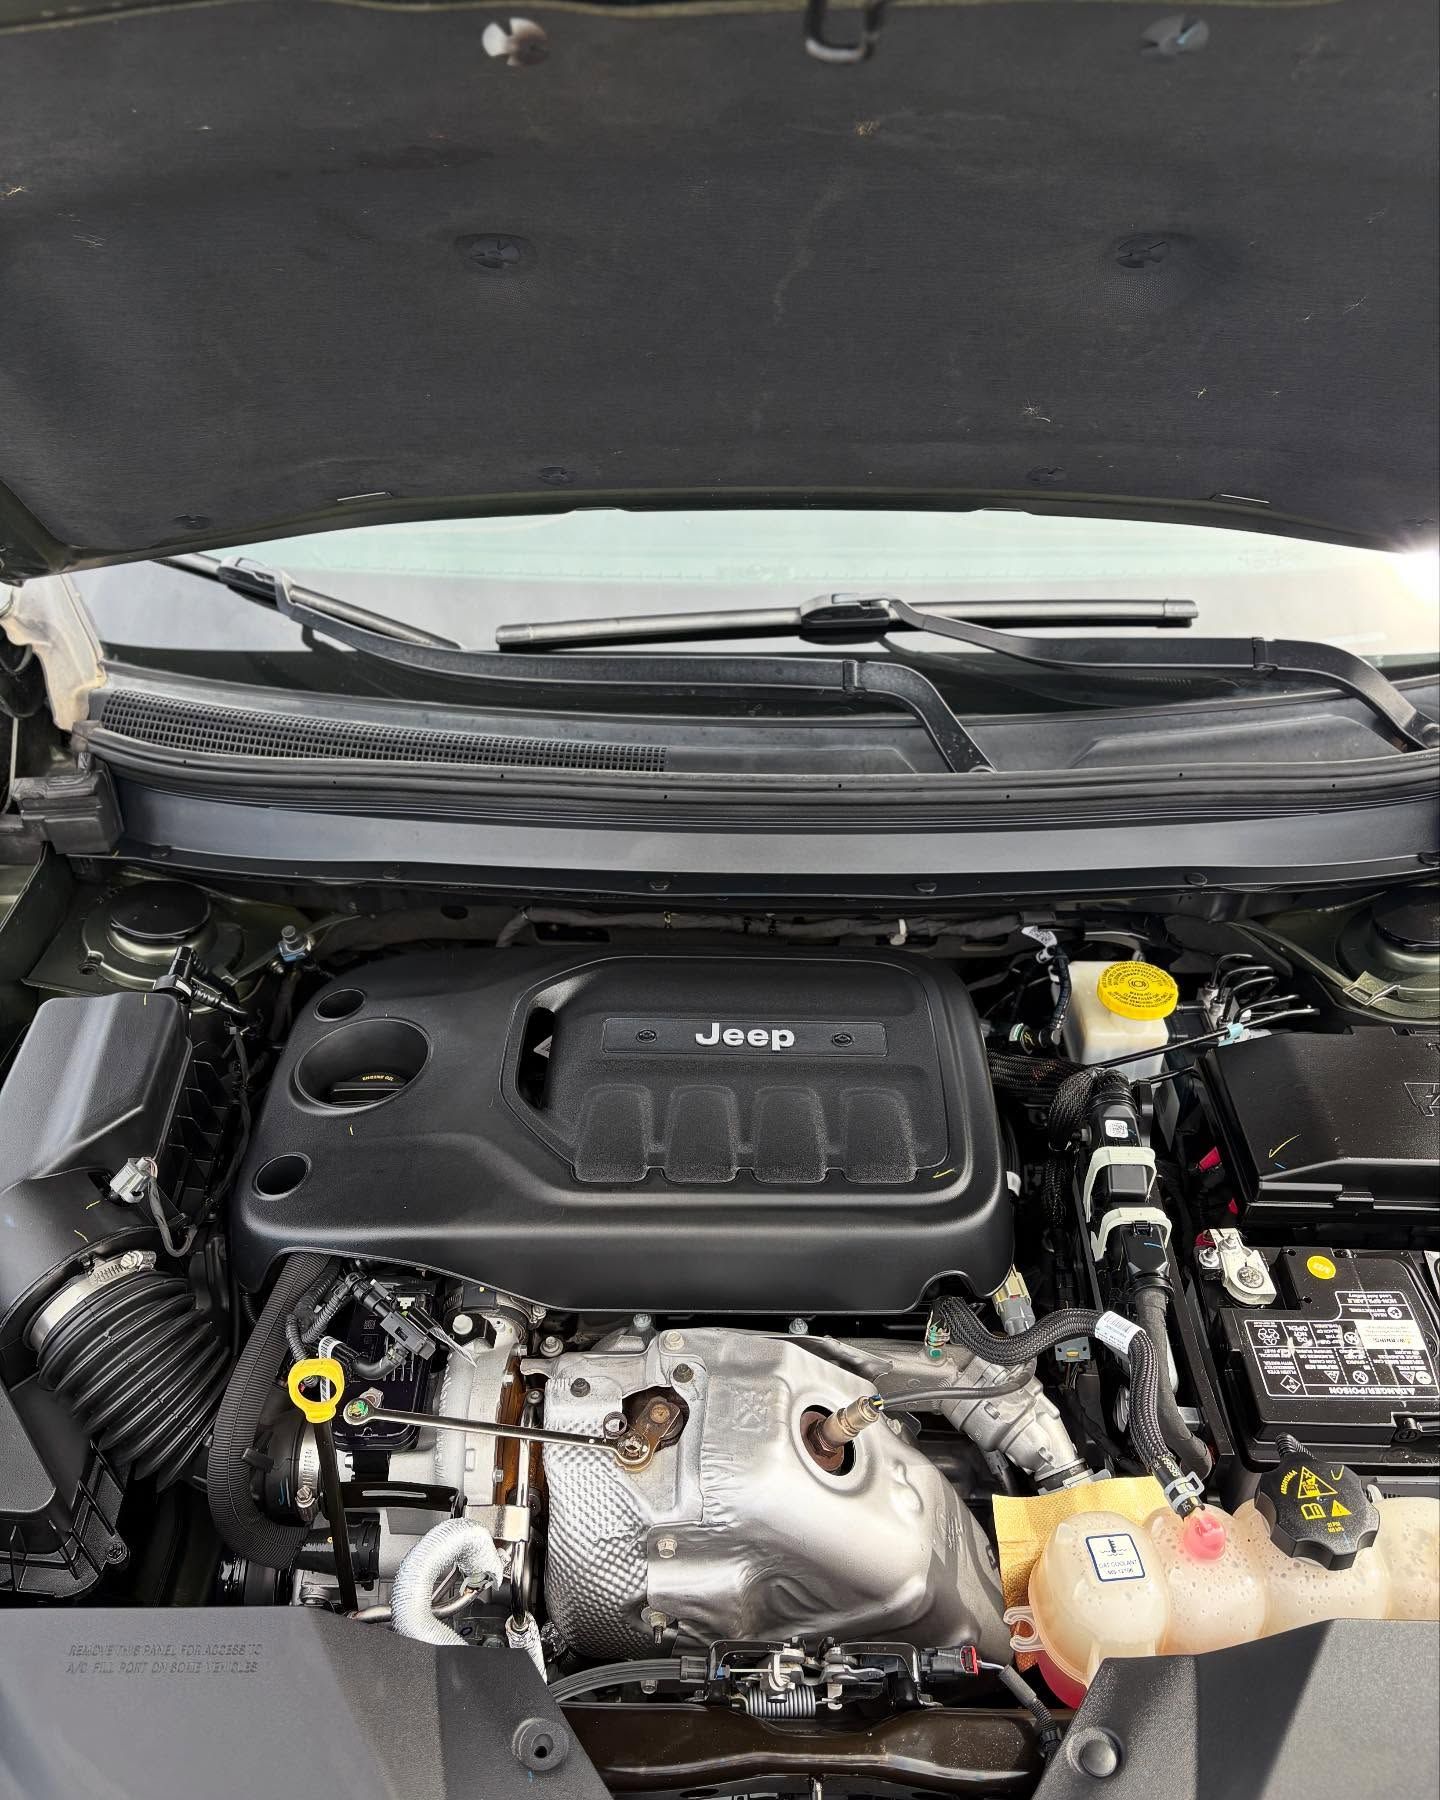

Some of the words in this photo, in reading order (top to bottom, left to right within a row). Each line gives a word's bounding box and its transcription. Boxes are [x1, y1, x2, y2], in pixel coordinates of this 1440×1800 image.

[695, 1022, 795, 1051] Jeep
[69, 1644, 113, 1656] REMOVE
[142, 1644, 177, 1656] PANEL
[181, 1644, 202, 1656] FOR
[203, 1644, 247, 1656] ACCESS
[119, 1662, 149, 1674] PORT
[152, 1662, 168, 1674] ON
[169, 1662, 202, 1674] SOME
